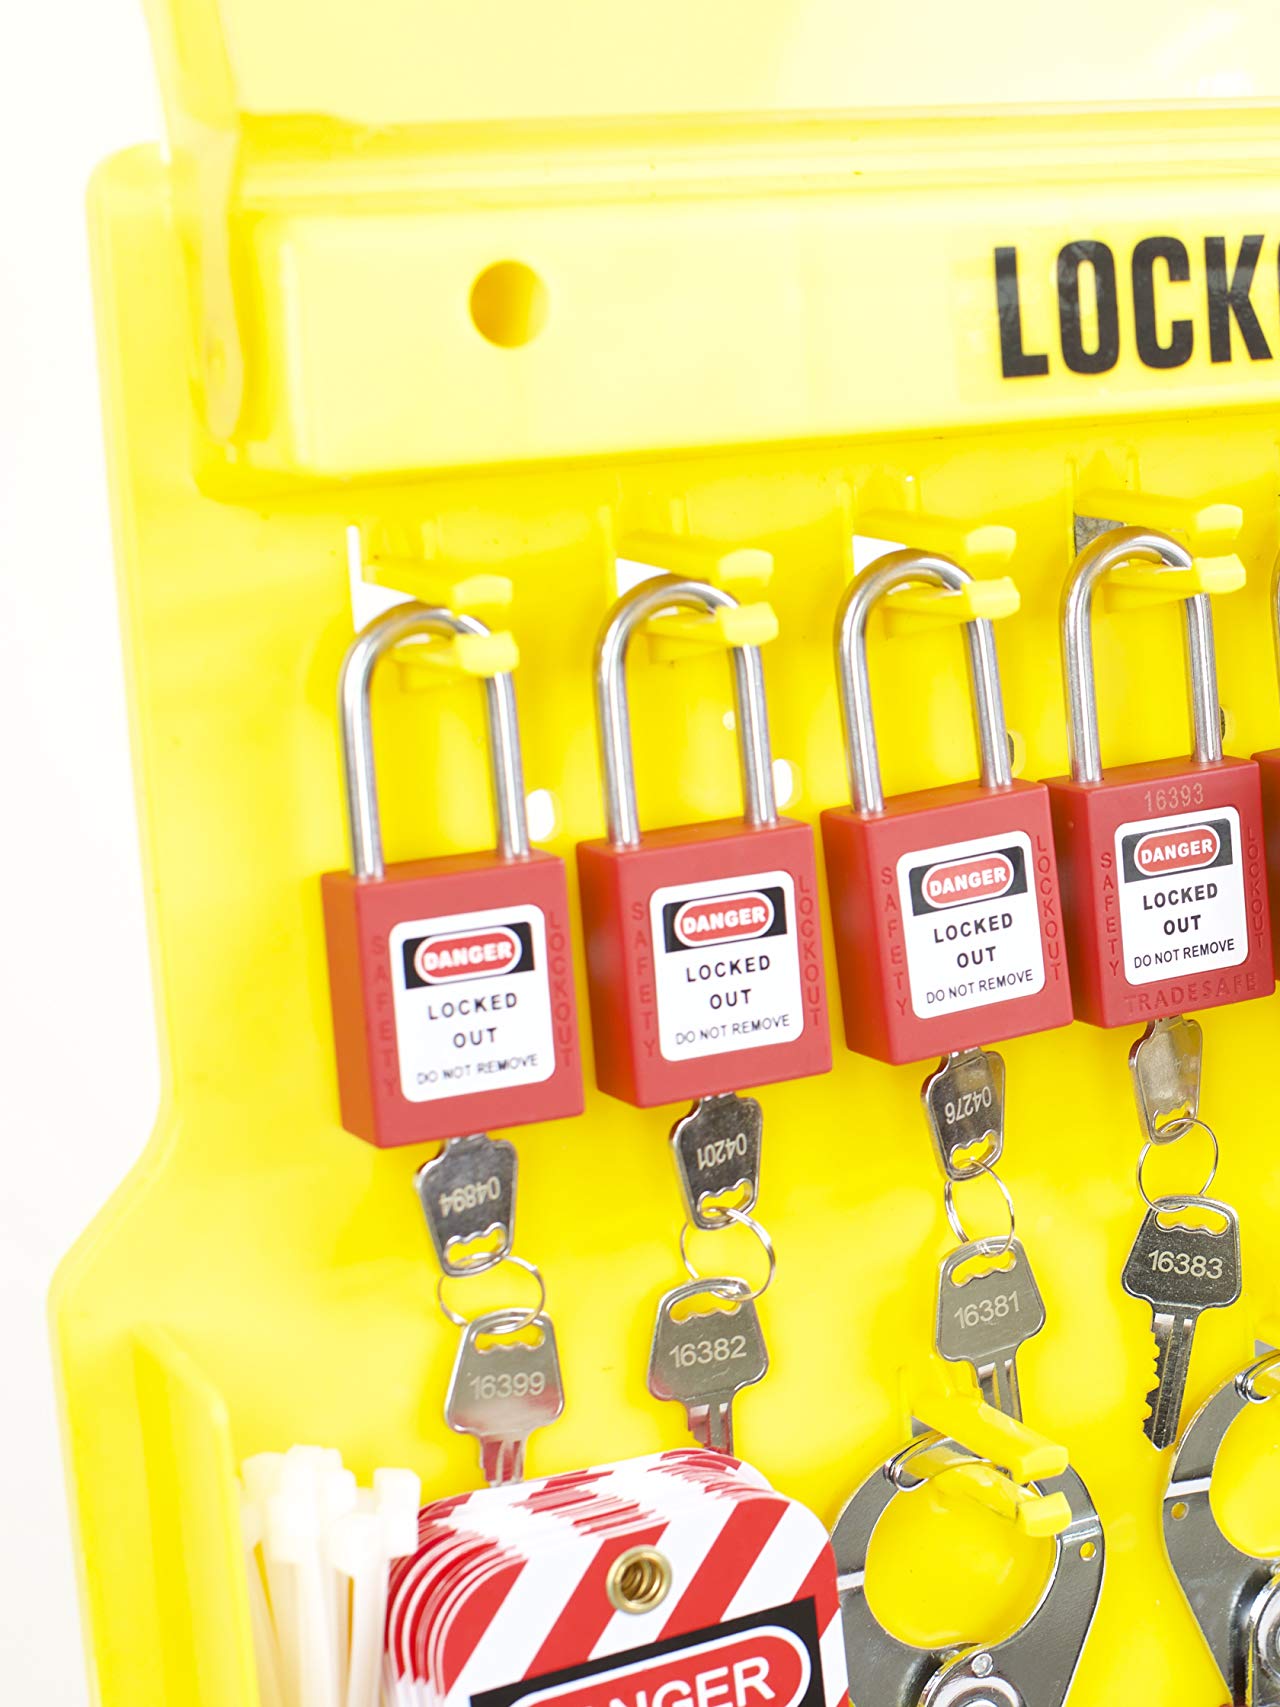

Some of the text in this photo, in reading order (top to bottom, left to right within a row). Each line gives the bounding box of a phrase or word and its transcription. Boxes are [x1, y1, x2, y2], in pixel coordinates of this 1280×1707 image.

[1144, 783, 1204, 813] 16393
[1141, 838, 1213, 864] DANGER
[930, 867, 1007, 897] DANGER
[1143, 883, 1218, 910] LOCKED
[1247, 827, 1264, 948] LOCKOUT
[683, 906, 766, 934] DANGER
[1037, 836, 1061, 980] LOCKOUT
[1101, 853, 1119, 976] SAFETY
[934, 913, 1013, 943] LOCKED
[1164, 915, 1201, 935] OUT
[423, 942, 512, 971] DANGER
[799, 875, 821, 1026] LOCKOUT
[881, 867, 906, 1016] SAFETY
[1134, 939, 1234, 968] DO NOT REMOVE
[687, 955, 770, 982] LOCKED
[957, 946, 996, 968] OUT
[632, 902, 655, 1056] SAFETY
[926, 969, 1033, 1003] DO NOT REMOVE
[1123, 973, 1257, 1015] TRADESAFE
[428, 992, 517, 1020] LOCKED
[710, 989, 751, 1009] OUT
[453, 1028, 497, 1048] OUT
[676, 1014, 790, 1045] DO NOT REMOVE
[417, 1054, 538, 1084] DO NOT REMOVE
[944, 1086, 992, 1124] 04276
[697, 1133, 747, 1170] 04201
[439, 1176, 500, 1217] 04894
[1148, 1250, 1223, 1279] 16383
[953, 1291, 1020, 1329] 16381
[669, 1335, 747, 1369] 16382
[469, 1372, 545, 1400] 16399
